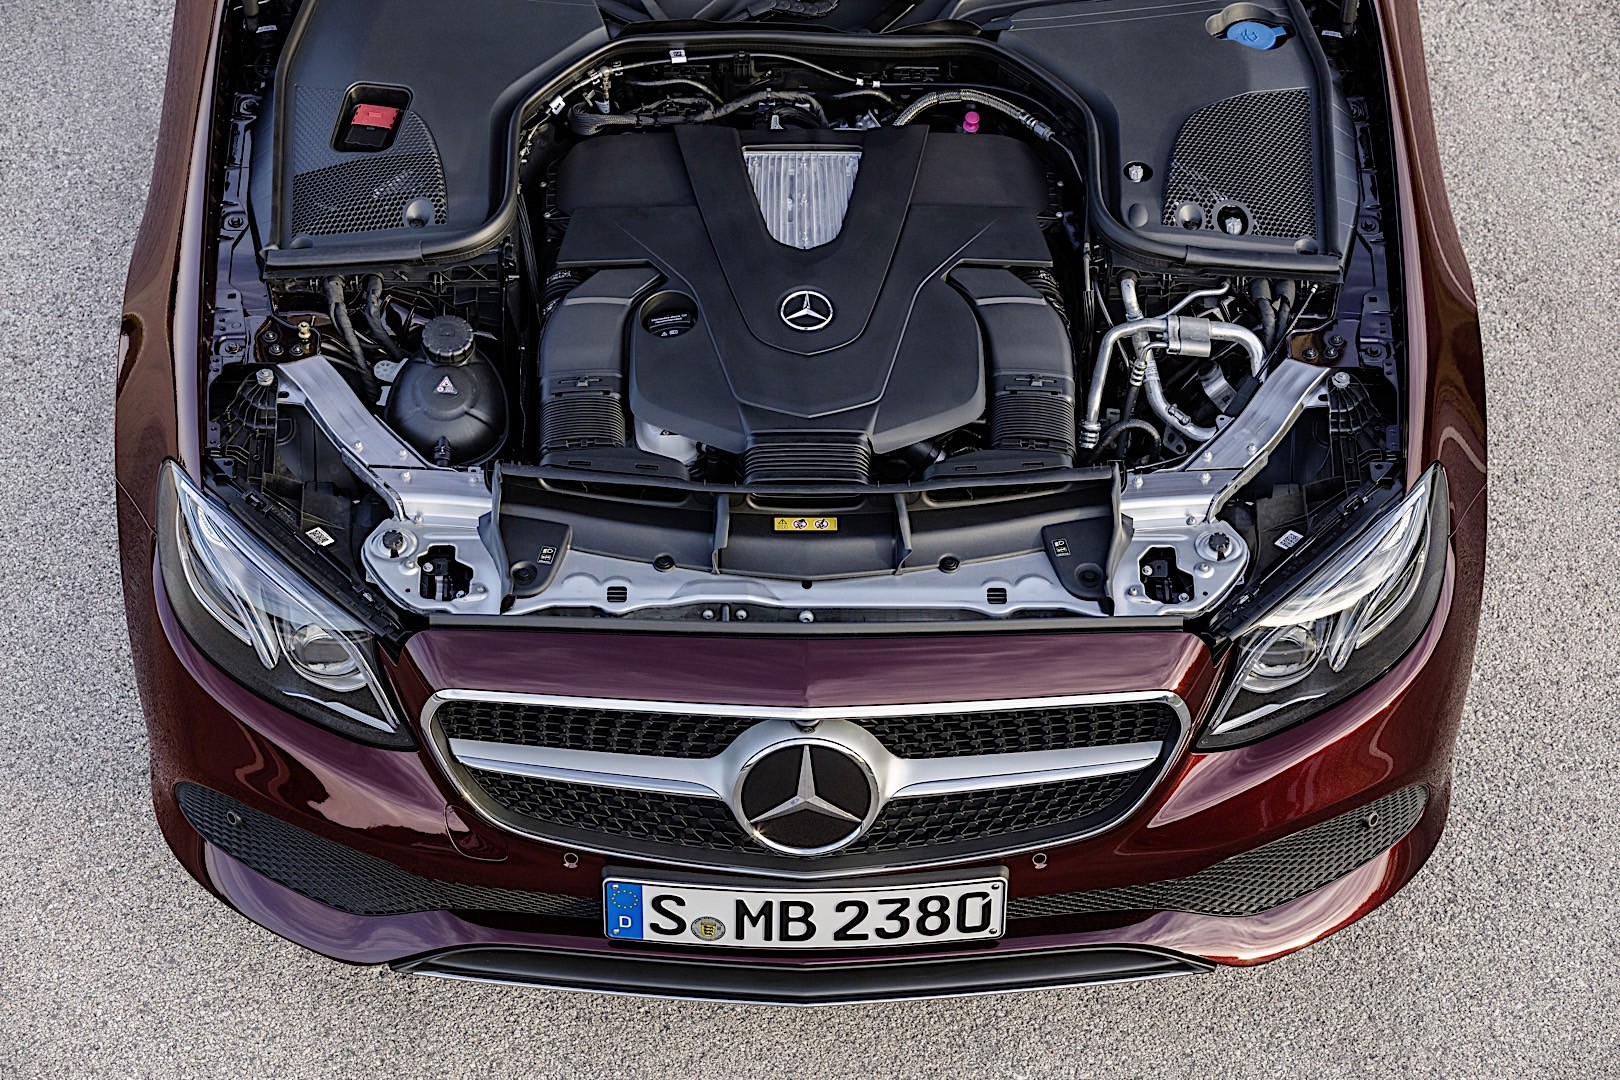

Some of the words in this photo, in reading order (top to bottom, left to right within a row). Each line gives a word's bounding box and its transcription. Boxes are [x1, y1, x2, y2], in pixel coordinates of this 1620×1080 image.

[619, 915, 632, 928] D
[650, 894, 687, 936] S
[735, 900, 817, 942] MB
[833, 891, 992, 942] 2380
